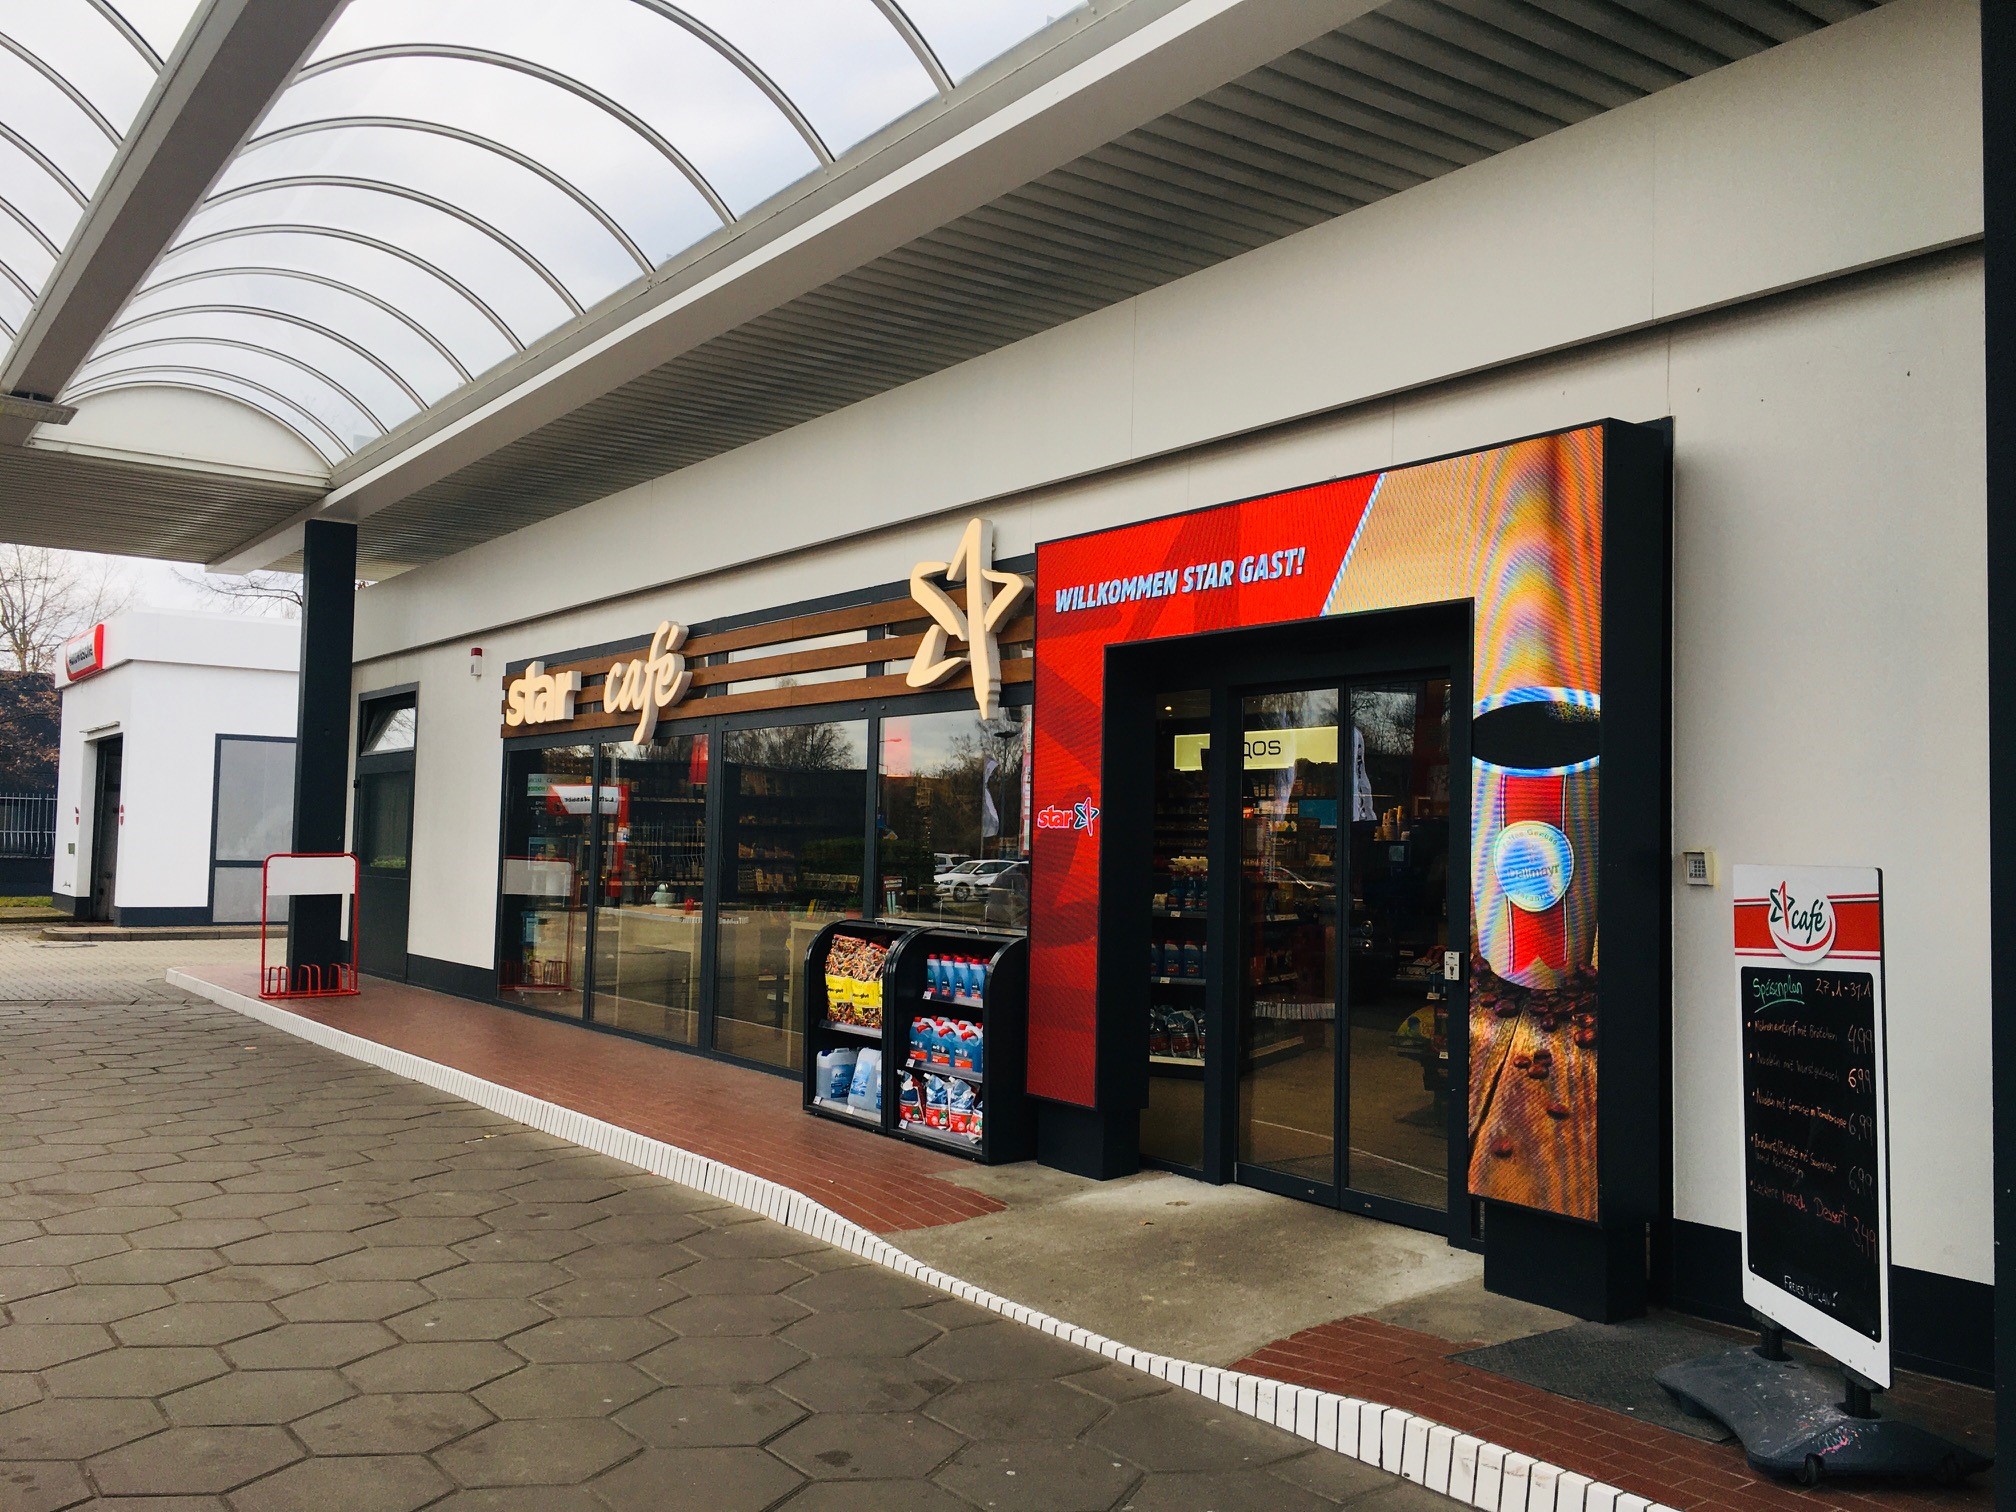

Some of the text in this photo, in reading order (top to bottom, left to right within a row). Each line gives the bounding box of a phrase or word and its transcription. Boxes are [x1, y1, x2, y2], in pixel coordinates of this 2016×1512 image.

[1055, 547, 1306, 613] WILLKOMMEN STAR GAST!
[506, 620, 692, 745] star café
[1243, 740, 1281, 759] QOS
[1037, 804, 1074, 829] star
[1507, 862, 1560, 880] Dallmayr
[1791, 898, 1826, 944] café
[1847, 1024, 1873, 1054] 4,99
[1848, 1068, 1872, 1093] 6,99
[1849, 1112, 1873, 1146] 6,99
[1849, 1165, 1873, 1200] 6,99
